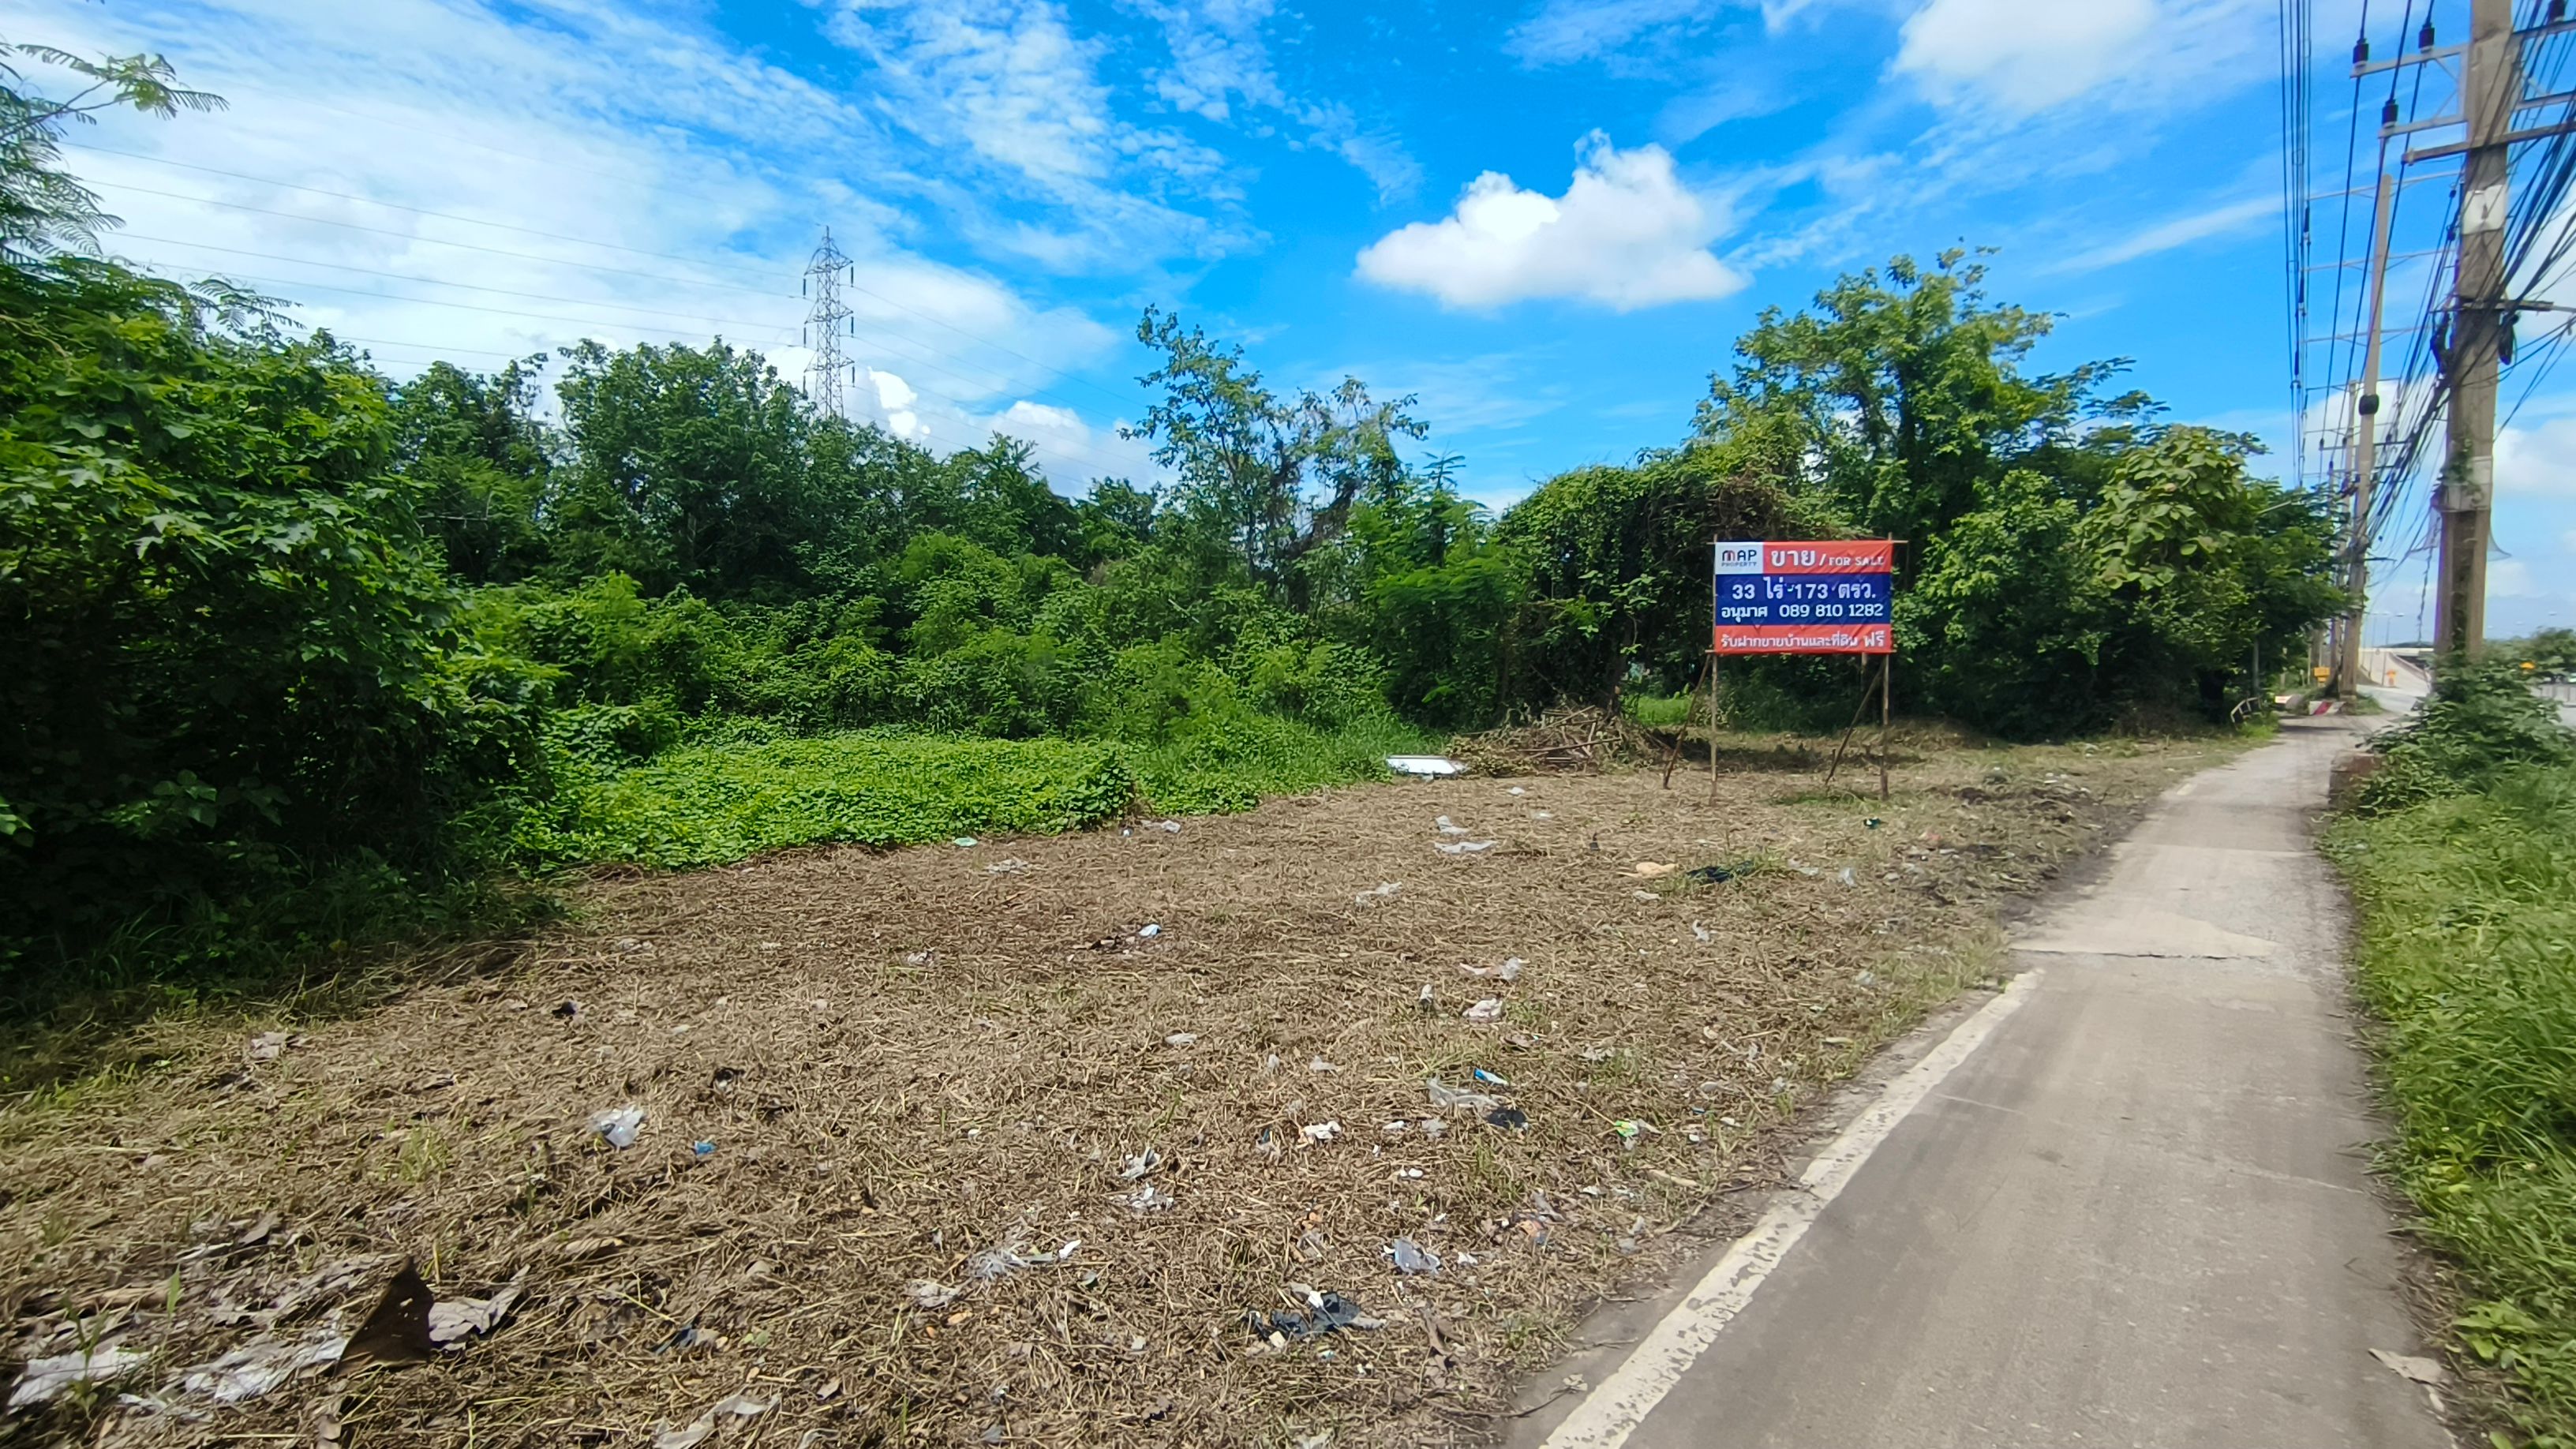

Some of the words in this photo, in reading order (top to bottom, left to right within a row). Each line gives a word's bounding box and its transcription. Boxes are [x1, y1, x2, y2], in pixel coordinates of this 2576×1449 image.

[1771, 550, 1815, 567] ขาย
[1829, 557, 1851, 566] FOR
[1732, 584, 1755, 600] 33
[1763, 576, 1784, 600] ไร่
[1795, 583, 1829, 600] 173
[1838, 583, 1877, 600] ตรว.
[1779, 604, 1810, 617] 089
[1815, 604, 1843, 617] 810
[1848, 604, 1884, 617] 1282
[1863, 631, 1885, 647] ฟรี
